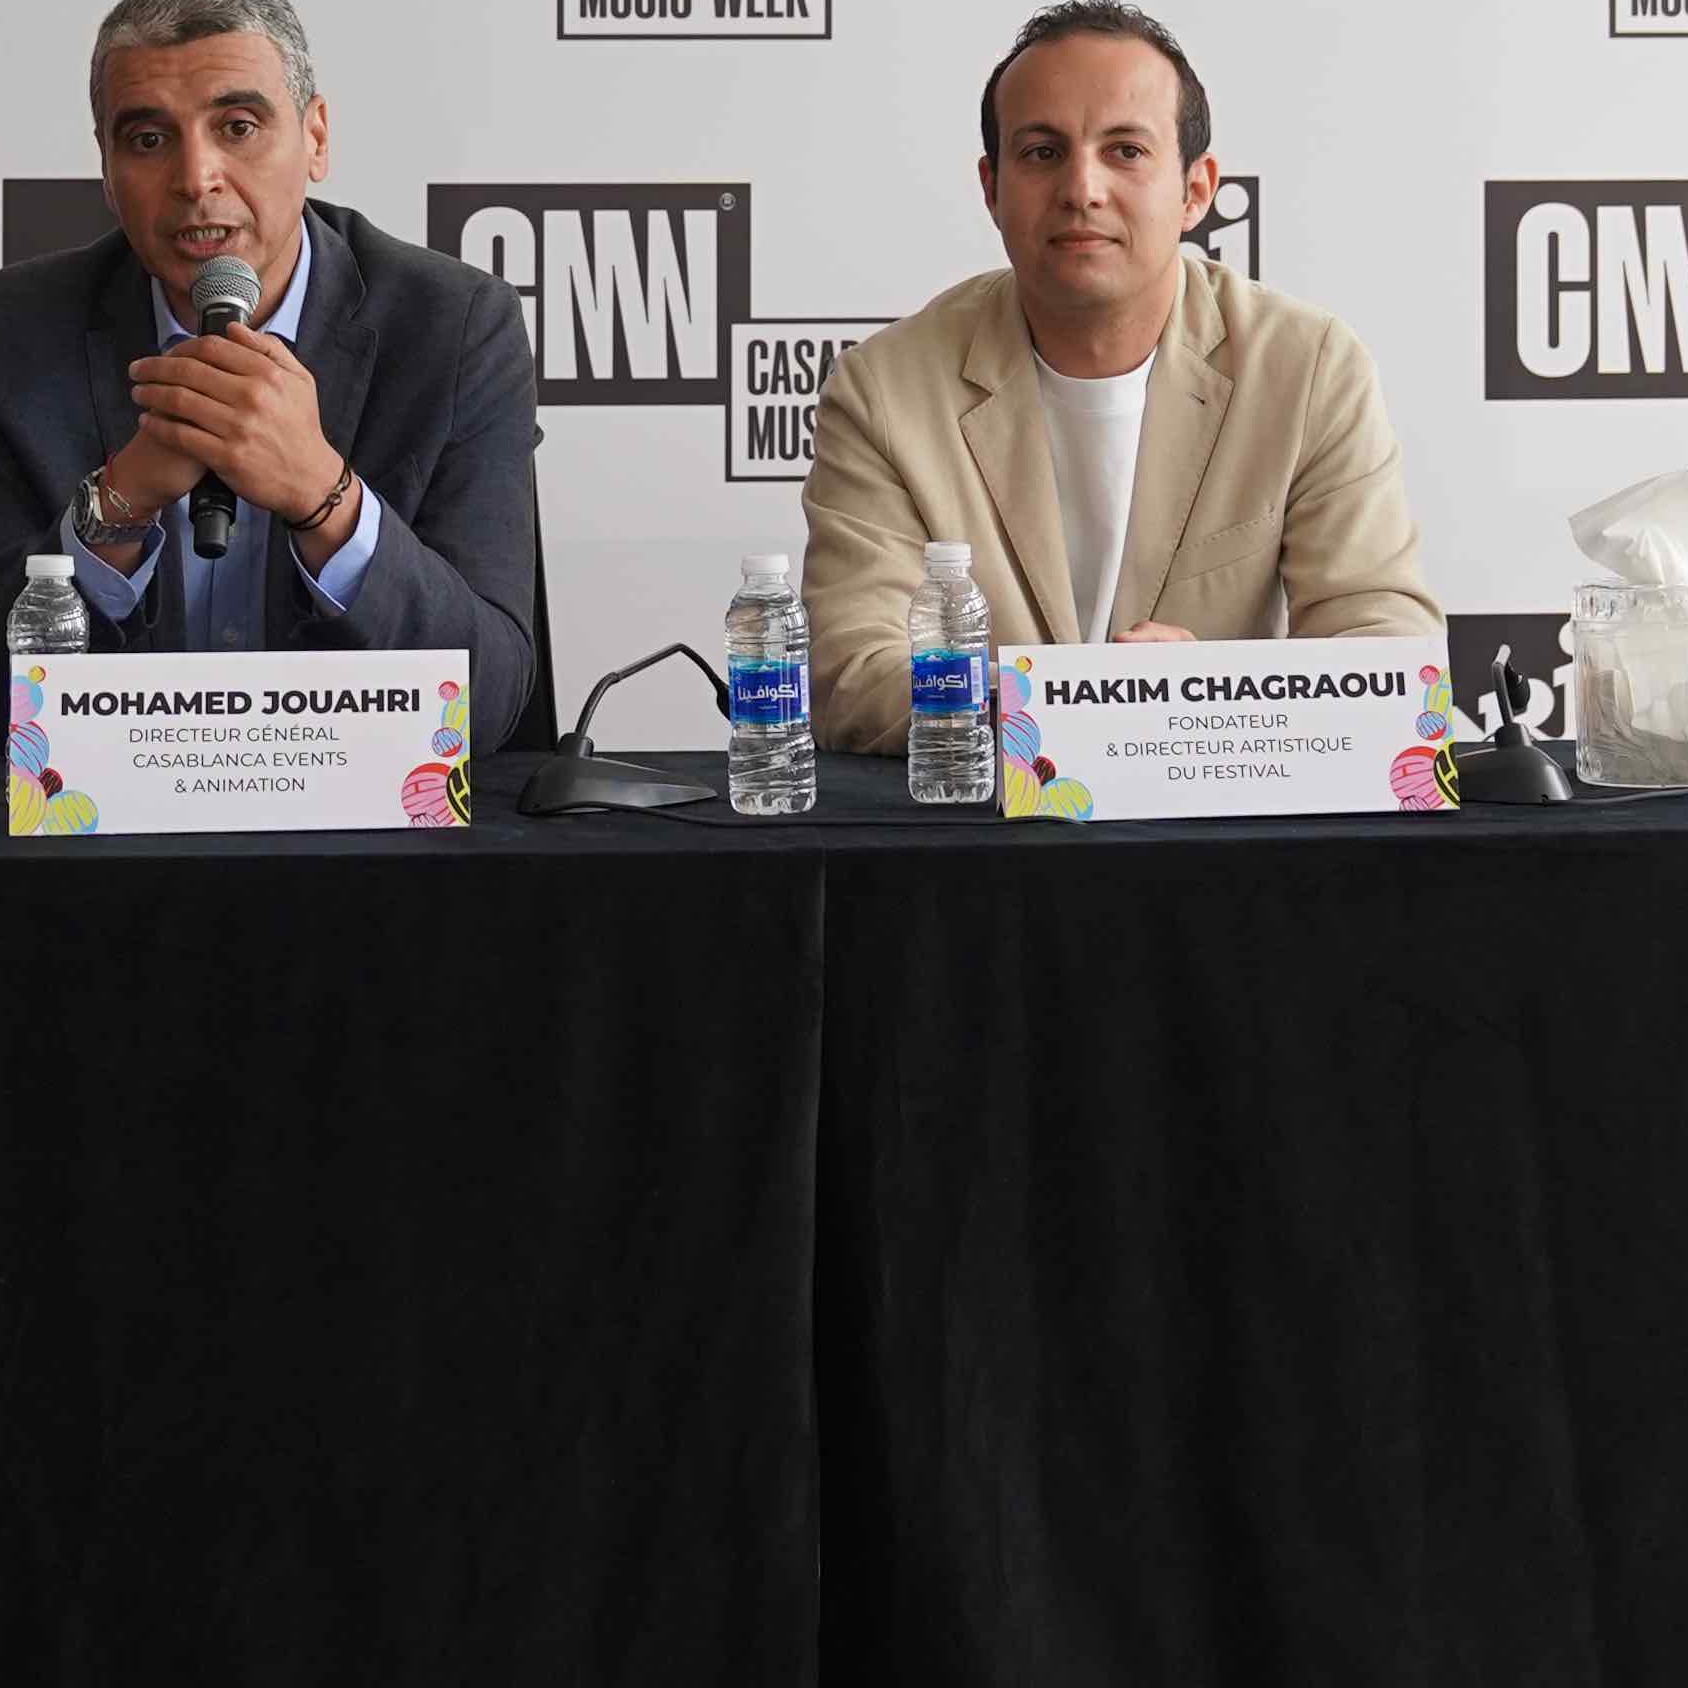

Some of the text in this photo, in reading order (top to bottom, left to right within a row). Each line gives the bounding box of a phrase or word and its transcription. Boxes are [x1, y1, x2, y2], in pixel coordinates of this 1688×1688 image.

[748, 405, 817, 461] MUS
[1044, 672, 1406, 705] HAKIM CHAGRAOUI
[60, 689, 420, 716] MOHAMED JOUAHRI
[1168, 714, 1288, 731] FONDATEUR
[129, 723, 340, 743] DIRECTEUR GÉNÉRAL
[1107, 737, 1353, 758] & DIRECTEUR ARTISTIQUE
[133, 752, 348, 768] CASABLANCA EVENTS
[1168, 764, 1291, 781] DU FESTIVAL
[174, 778, 305, 794] & ANIMATION
